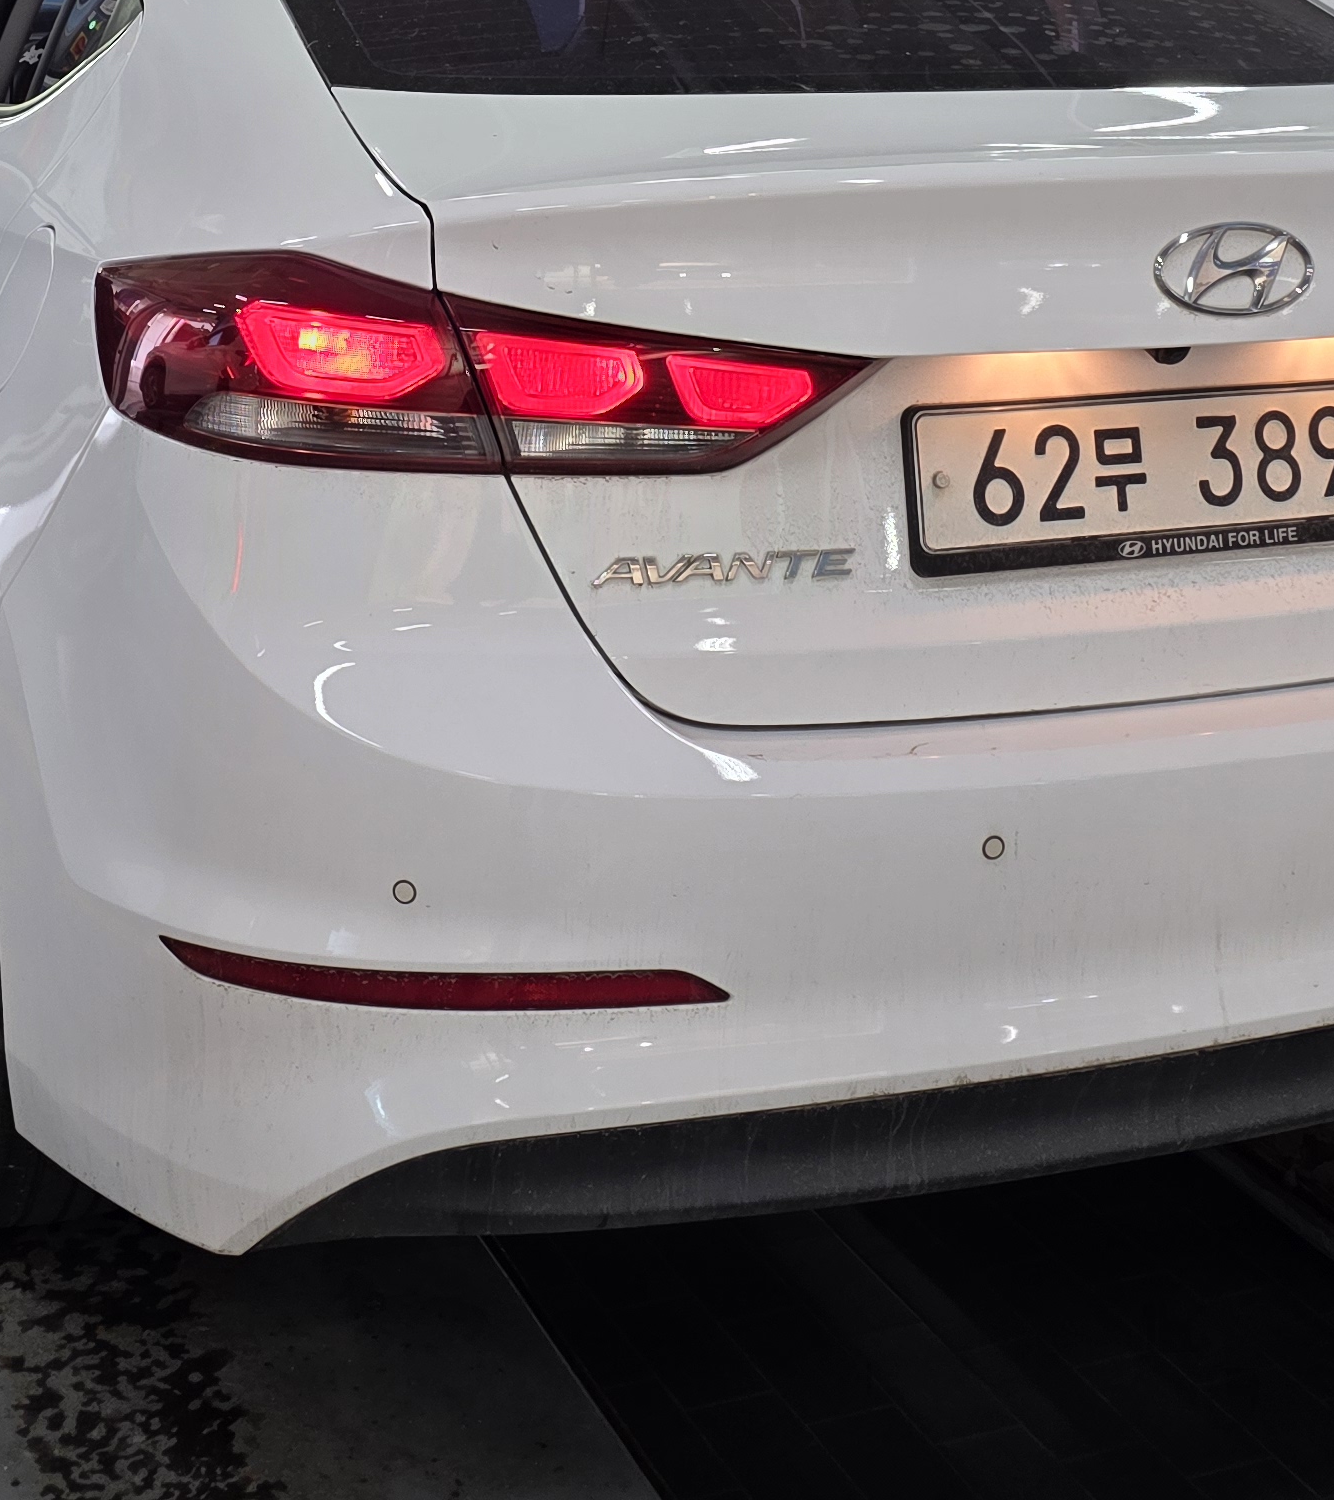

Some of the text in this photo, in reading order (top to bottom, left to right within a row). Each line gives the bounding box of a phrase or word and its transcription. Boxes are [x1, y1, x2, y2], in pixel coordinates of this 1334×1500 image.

[972, 424, 1147, 527] 62무
[1151, 527, 1298, 554] HYUNDAI FOR LIFE
[592, 548, 856, 587] AVANTE
